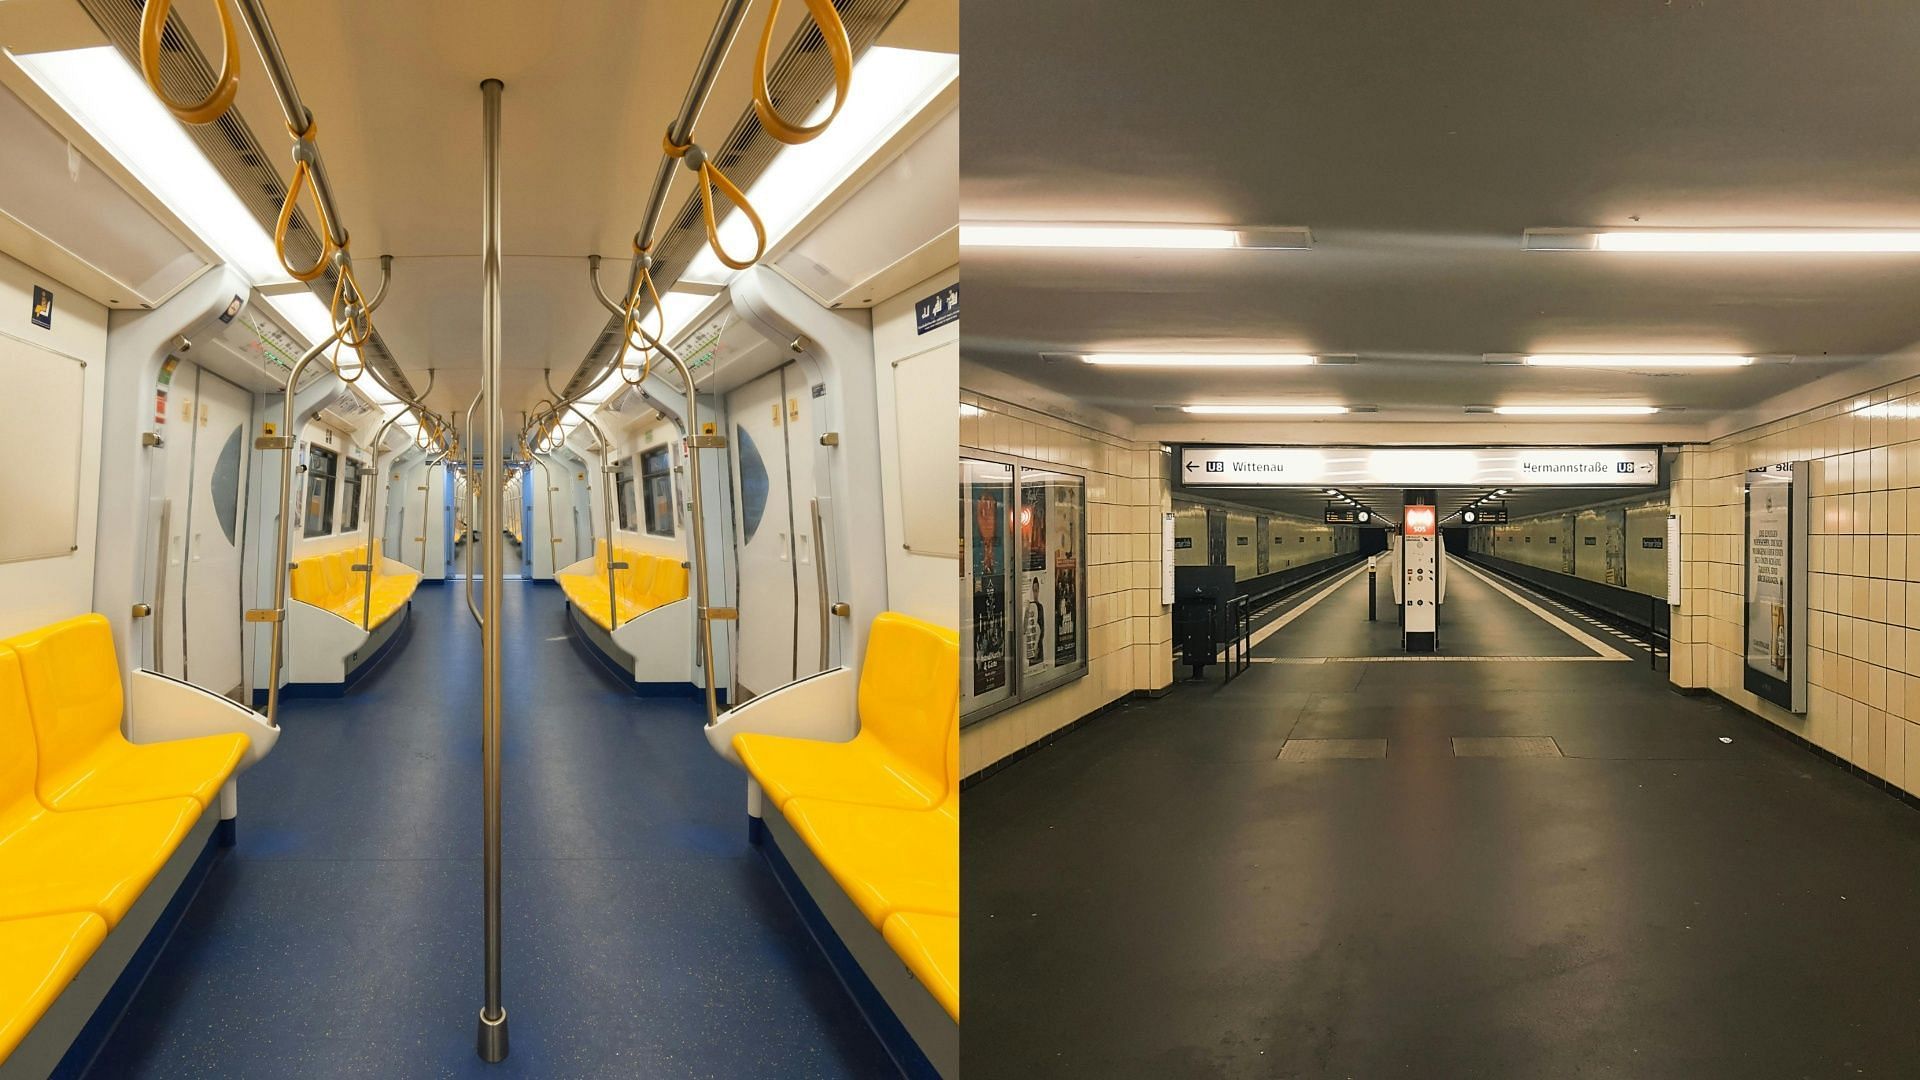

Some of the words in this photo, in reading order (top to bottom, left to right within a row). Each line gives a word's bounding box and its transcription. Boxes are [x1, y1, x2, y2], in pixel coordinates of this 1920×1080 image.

[1207, 462, 1223, 472] U8
[1233, 462, 1283, 472] Wittenau
[1523, 462, 1608, 472] Hermannstraße
[1617, 462, 1634, 473] U8
